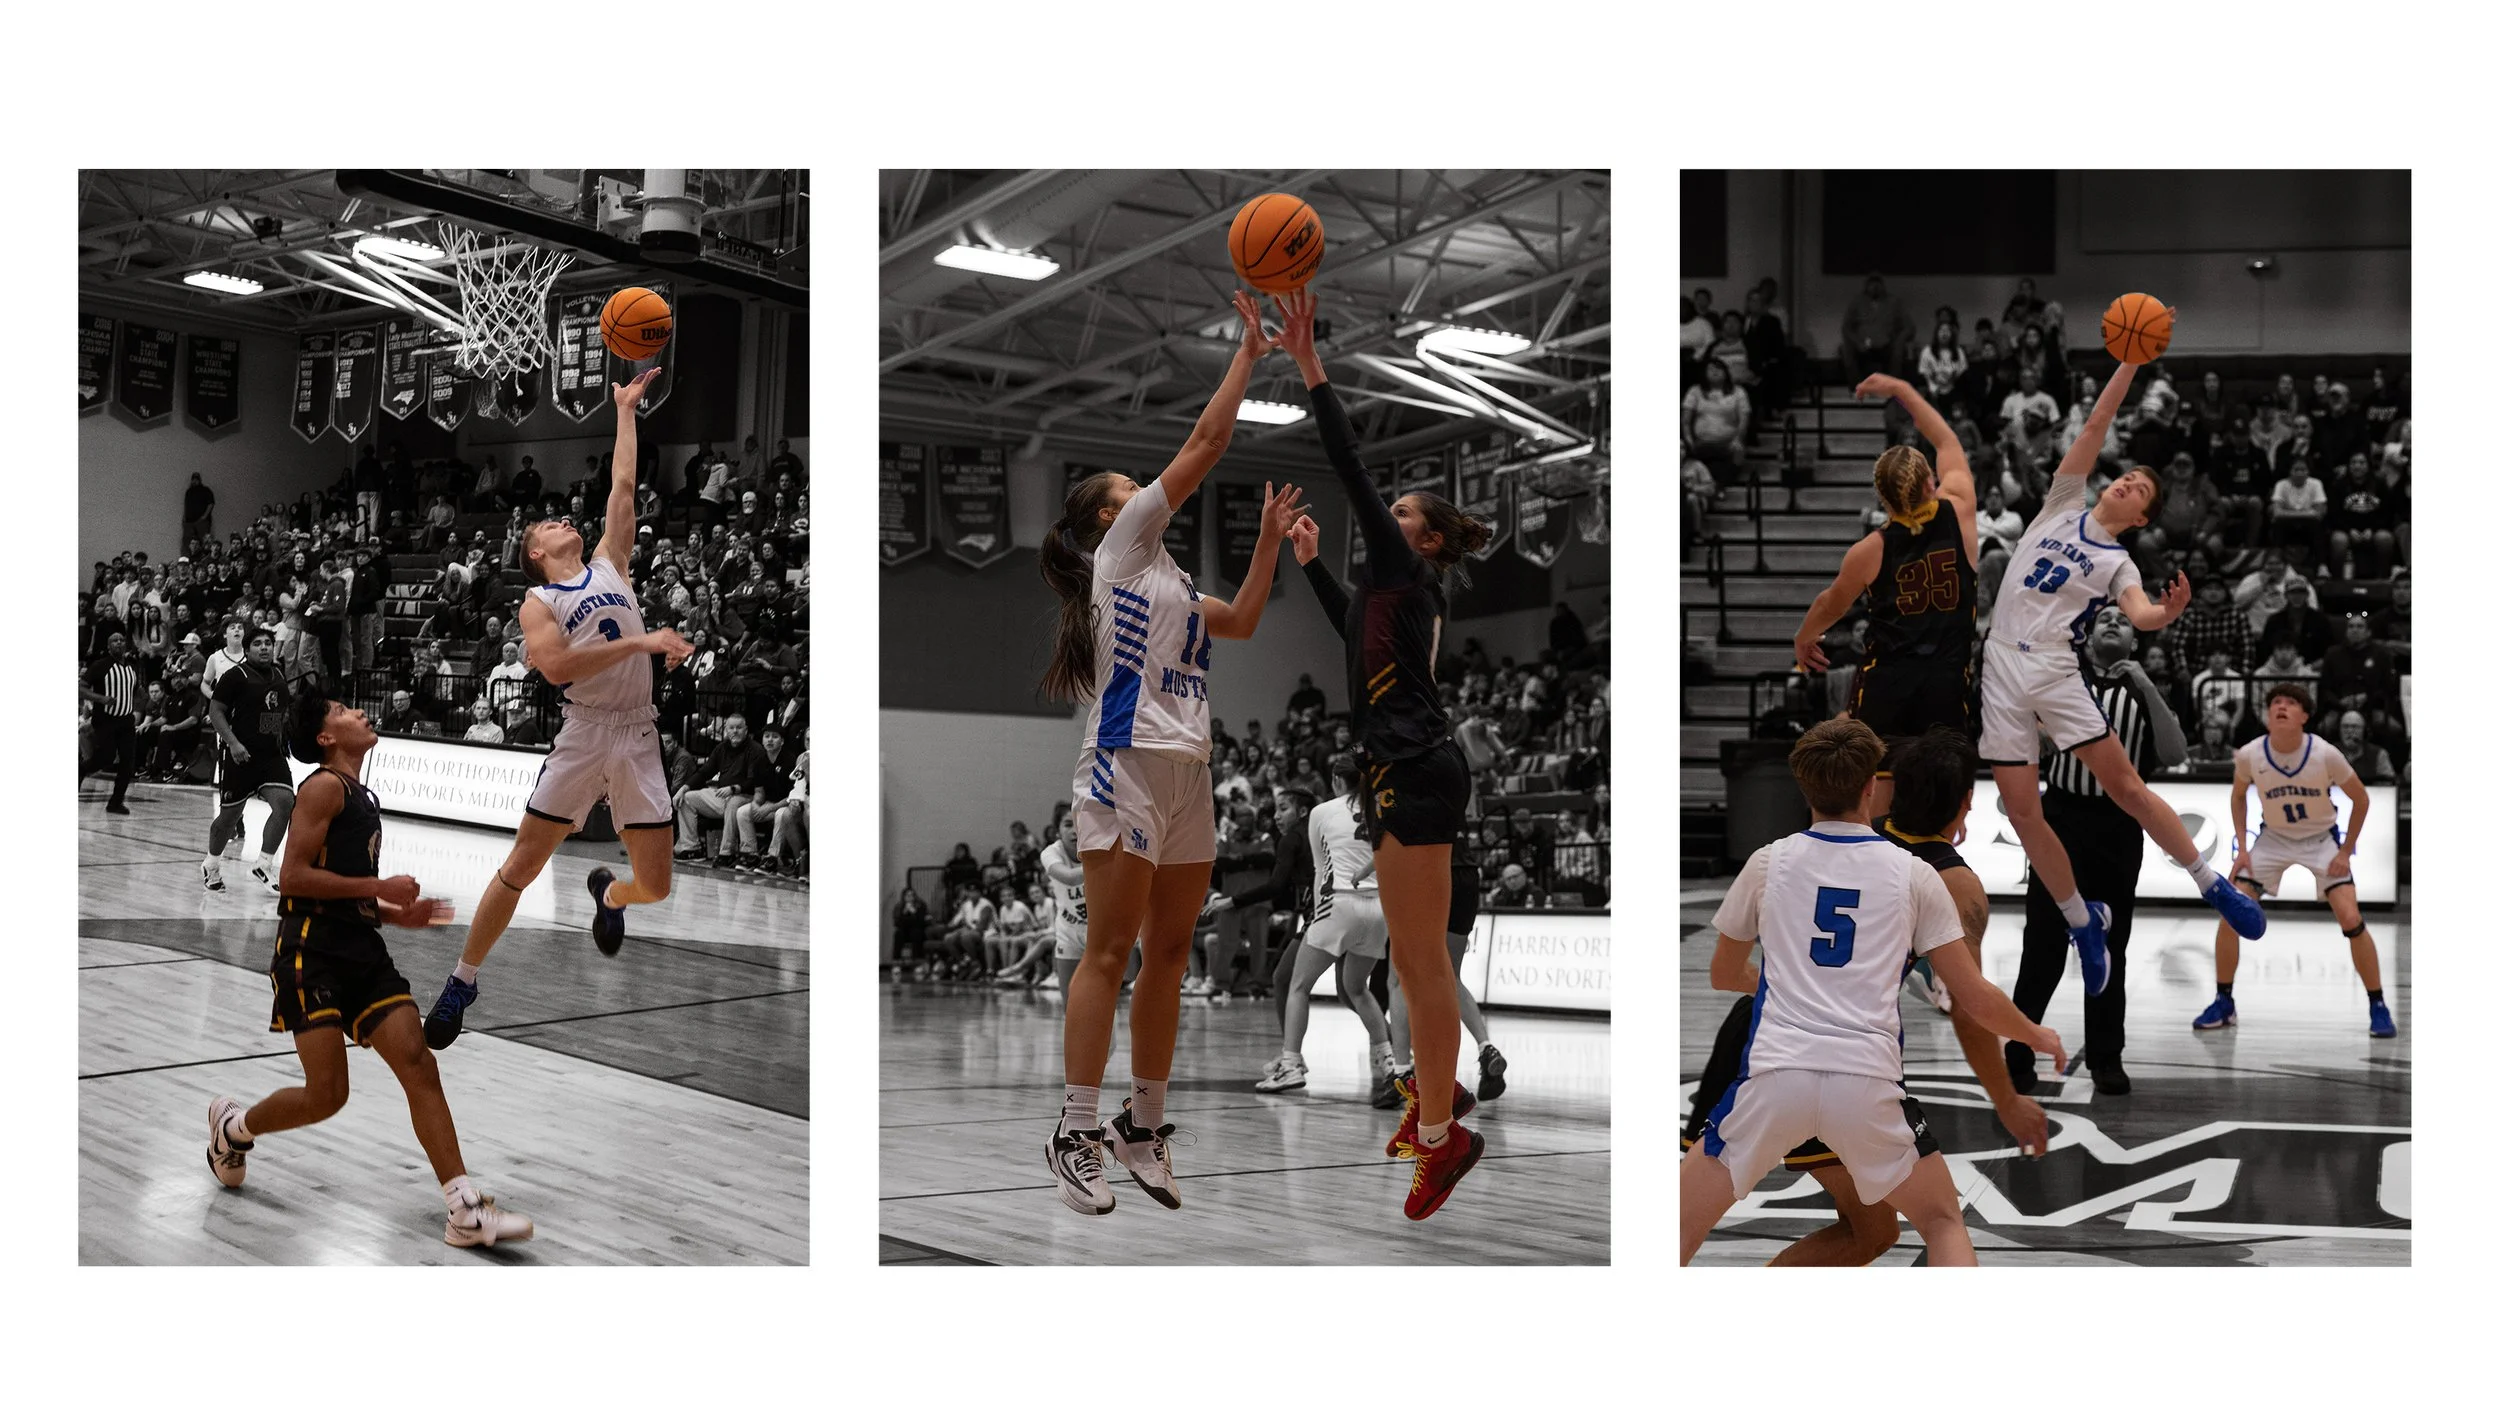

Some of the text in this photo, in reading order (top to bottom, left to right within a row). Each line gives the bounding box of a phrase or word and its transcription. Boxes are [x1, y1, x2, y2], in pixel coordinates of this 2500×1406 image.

[1895, 547, 1960, 617] 35
[2023, 557, 2071, 594] 33
[565, 592, 632, 635] MUSTANGS
[376, 752, 430, 773] HARRIS
[371, 777, 406, 795] AND
[409, 781, 464, 805] SPORTS
[2264, 784, 2322, 800] MUSTANGS
[2282, 803, 2308, 823] 11
[1809, 886, 1861, 968] 5
[1498, 933, 1567, 957] HARRIS
[1495, 967, 1539, 987] AND
